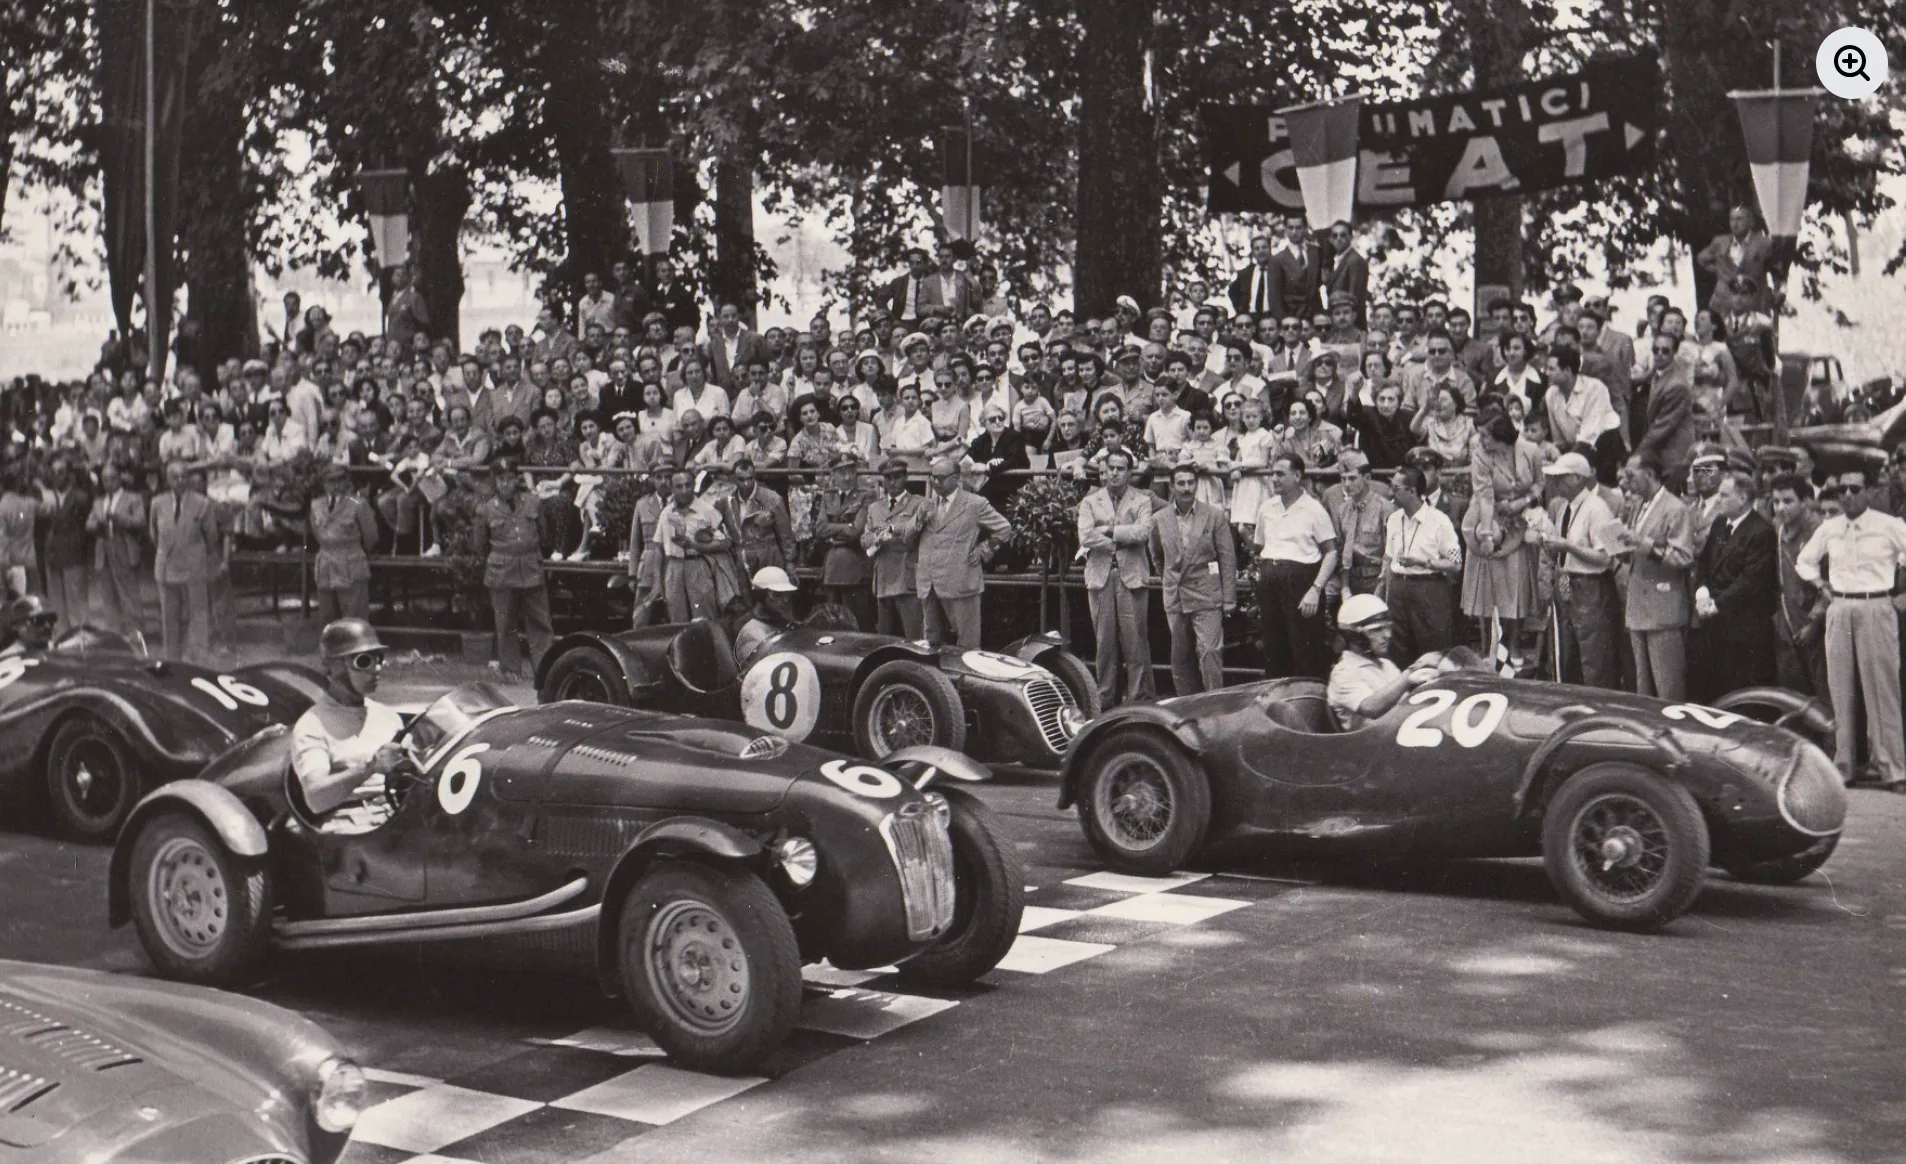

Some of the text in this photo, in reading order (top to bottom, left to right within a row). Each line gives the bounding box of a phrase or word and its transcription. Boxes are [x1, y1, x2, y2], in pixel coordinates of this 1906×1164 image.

[1267, 82, 1590, 143] PUMATICI
[1261, 112, 1609, 208] CEAT
[191, 675, 269, 711] 16
[764, 661, 798, 730] 8
[1396, 689, 1508, 748] 20
[438, 743, 491, 814] 6
[819, 759, 902, 798] 6
